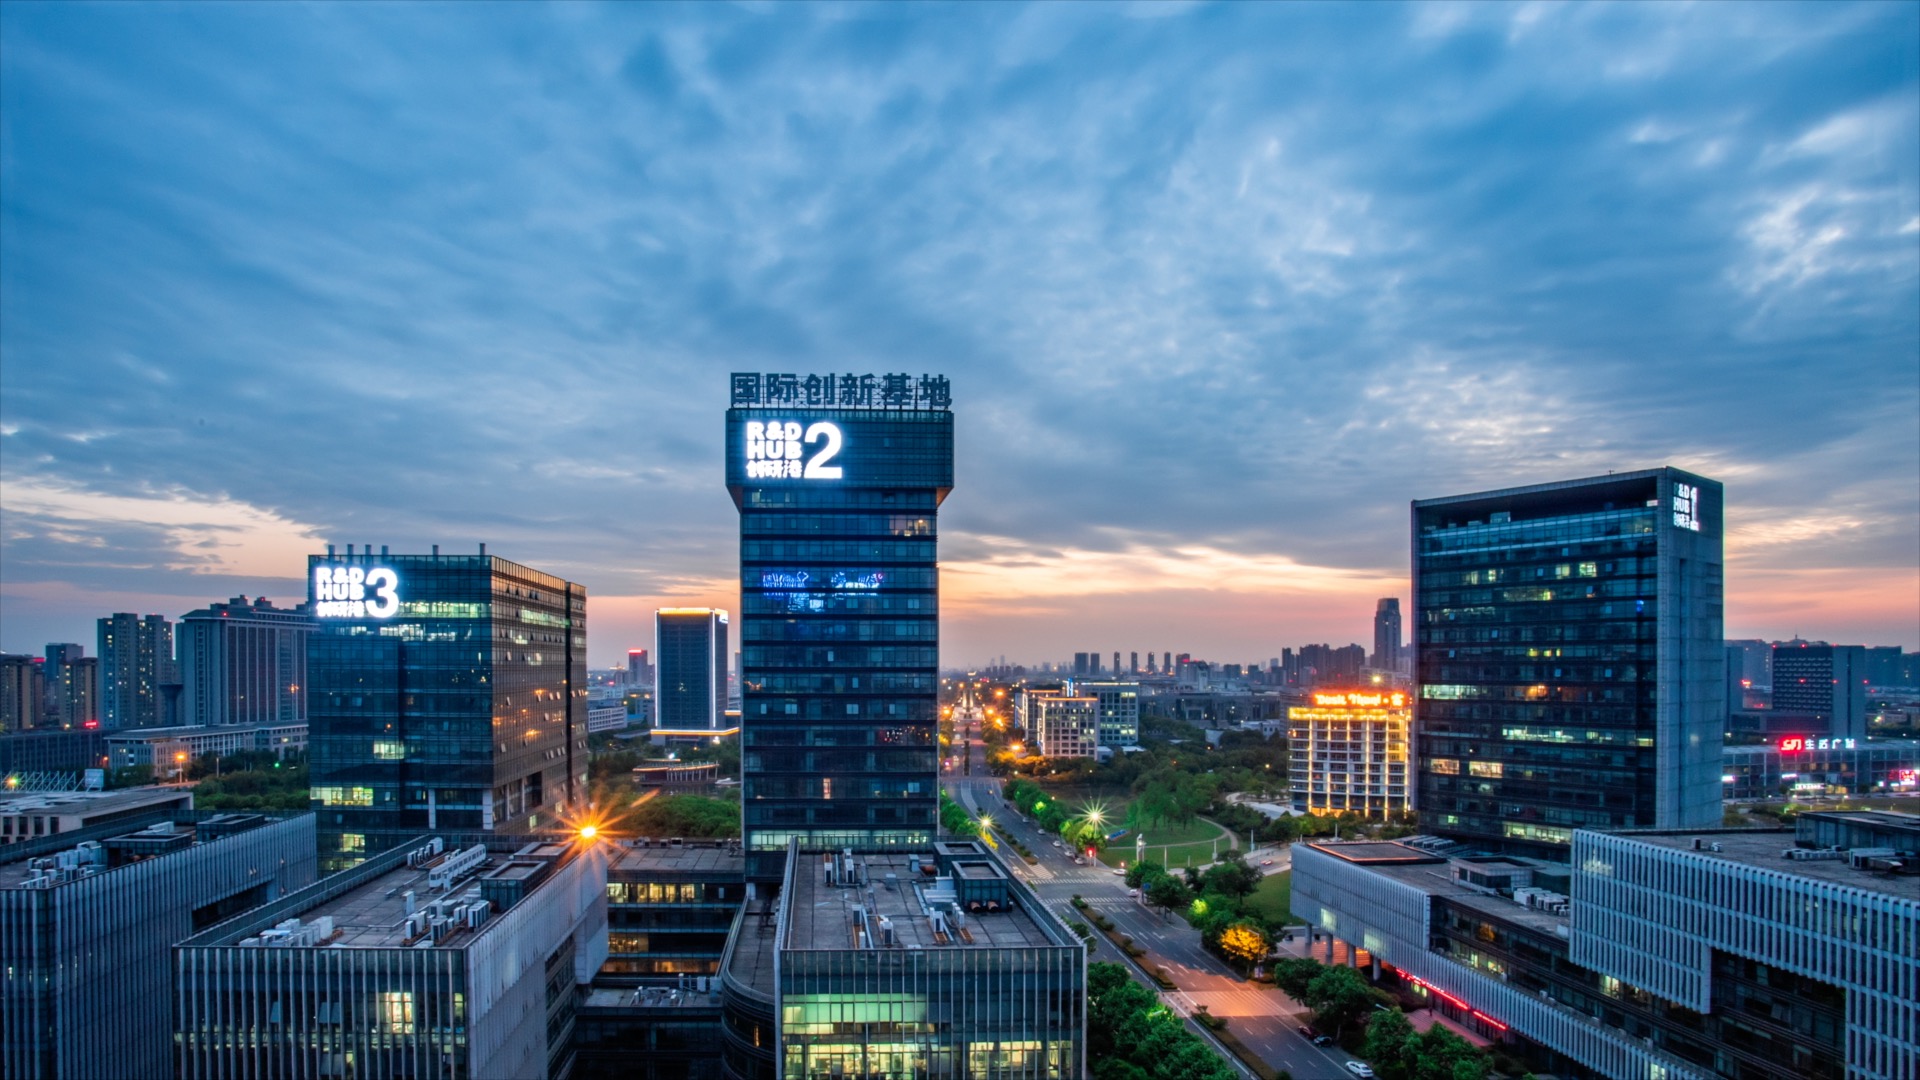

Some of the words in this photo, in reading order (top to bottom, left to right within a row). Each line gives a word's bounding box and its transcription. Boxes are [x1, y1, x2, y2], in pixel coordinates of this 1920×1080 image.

[730, 372, 952, 407] 国际创新基地
[746, 421, 802, 441] R&D
[746, 440, 802, 460] HUB
[803, 421, 842, 478] 2
[1673, 496, 1690, 513] HUB
[1690, 486, 1699, 531] 1
[316, 566, 365, 584] R&D
[316, 583, 365, 601] HUB
[365, 567, 399, 618] 3
